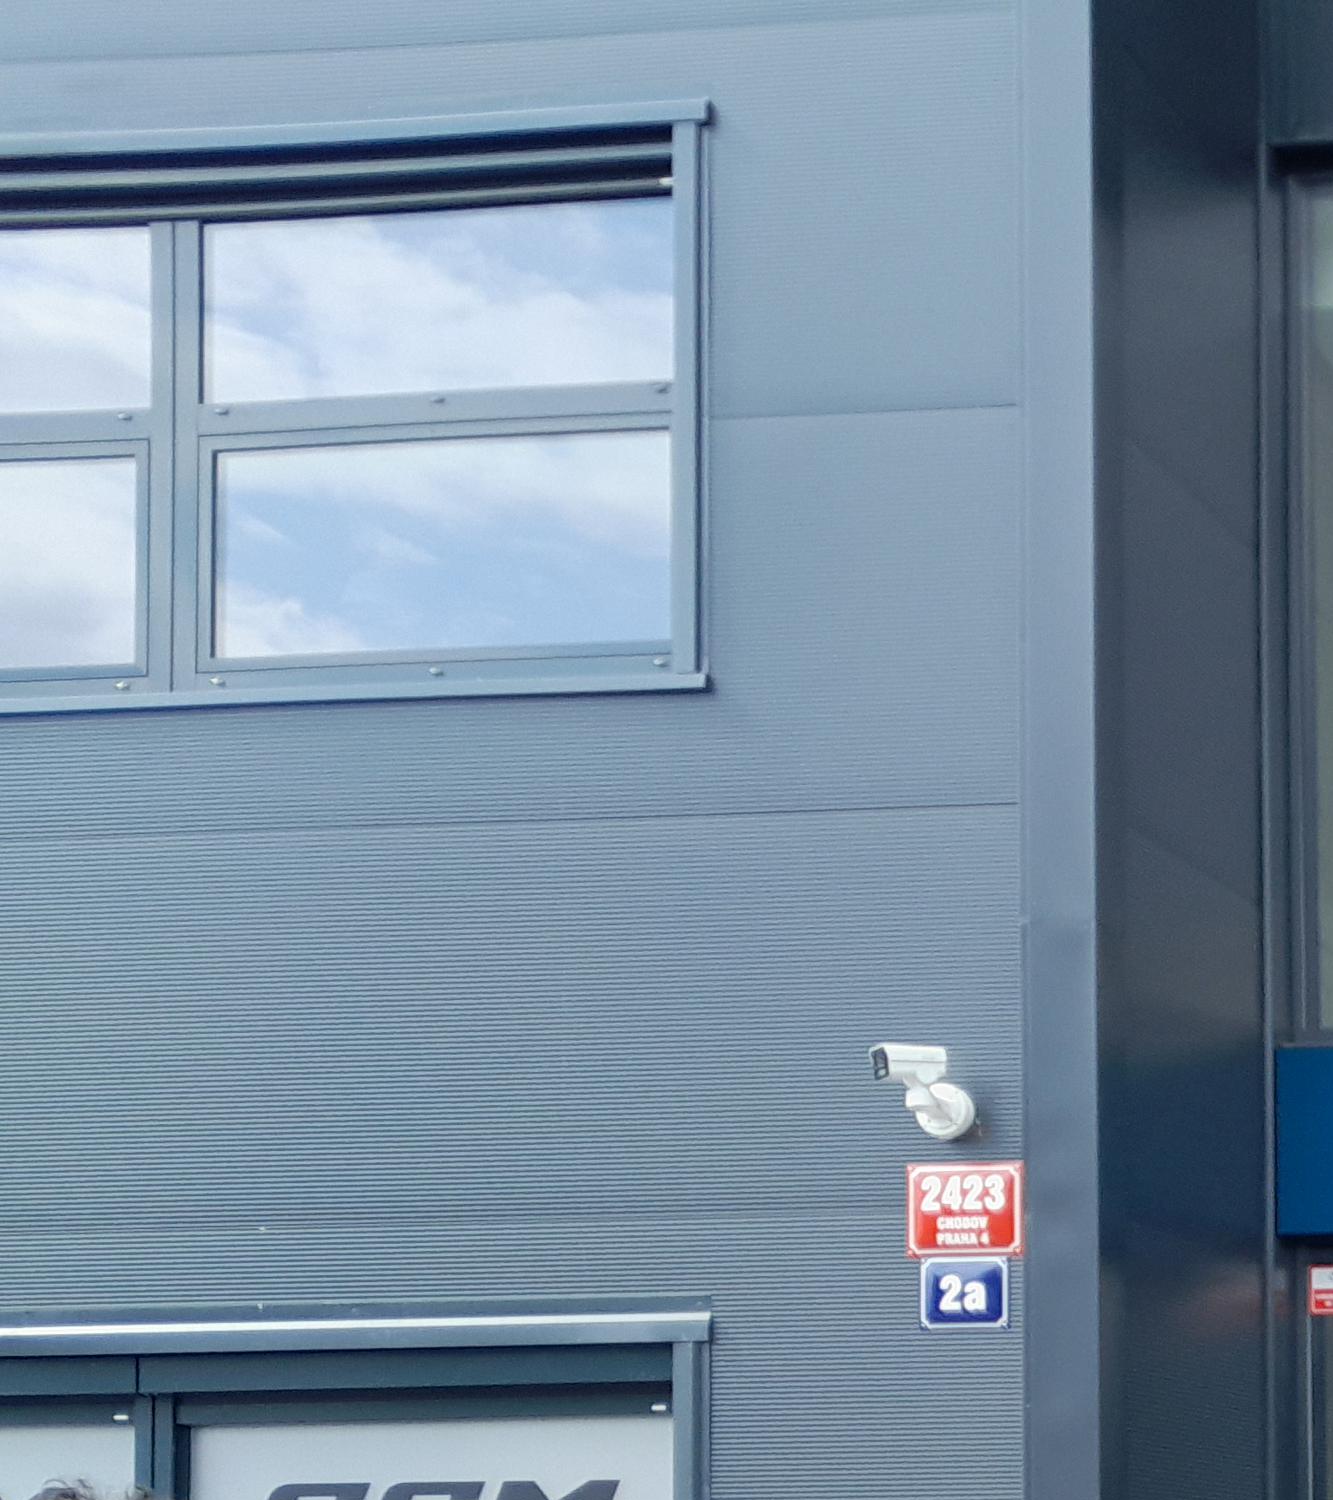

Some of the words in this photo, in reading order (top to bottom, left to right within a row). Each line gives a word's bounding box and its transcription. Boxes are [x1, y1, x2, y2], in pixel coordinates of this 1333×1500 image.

[920, 1174, 1006, 1212] 2423
[936, 1232, 977, 1246] PRAHA
[979, 1231, 990, 1245] 4
[938, 1274, 987, 1314] 2a
